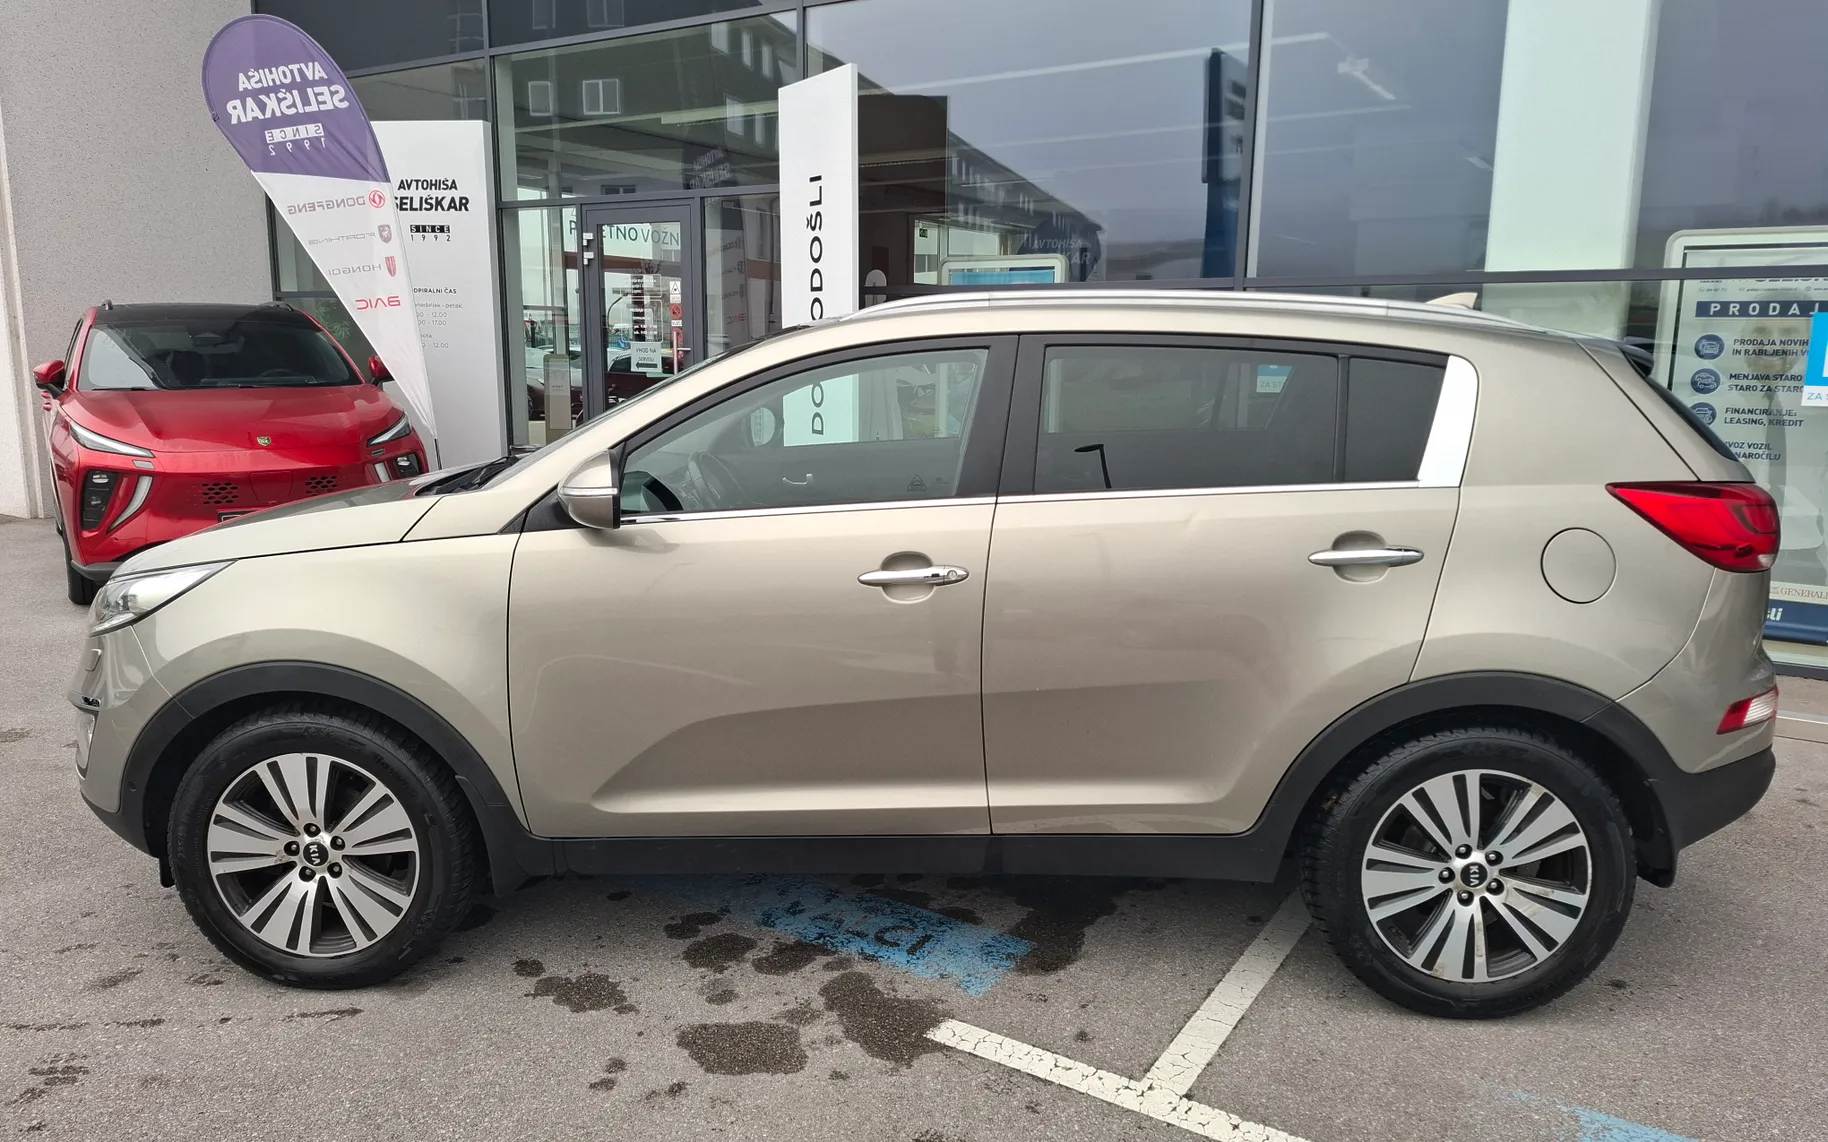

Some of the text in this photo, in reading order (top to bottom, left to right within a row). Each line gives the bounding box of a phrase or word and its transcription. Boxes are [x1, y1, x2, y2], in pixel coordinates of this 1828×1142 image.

[397, 177, 458, 191] AVTOHIŠA
[411, 225, 449, 233] SINCE
[410, 234, 451, 242] 1992
[444, 286, 457, 294] ČAS
[1733, 338, 1810, 347] PRODAJA NOVIH
[1732, 348, 1742, 356] IN
[1744, 348, 1798, 357] RABLJENIH
[1729, 372, 1803, 382] MENJAVA STARO
[1727, 384, 1758, 392] STARO
[1759, 384, 1772, 392] ZA
[1806, 392, 1823, 400] ZA
[1724, 417, 1805, 427] LEASING, KREDIT
[1725, 441, 1773, 451] VOZ VOZIL
[1735, 450, 1781, 461] NAROČILU
[309, 844, 321, 865] KIA
[1469, 865, 1480, 887] KIA
